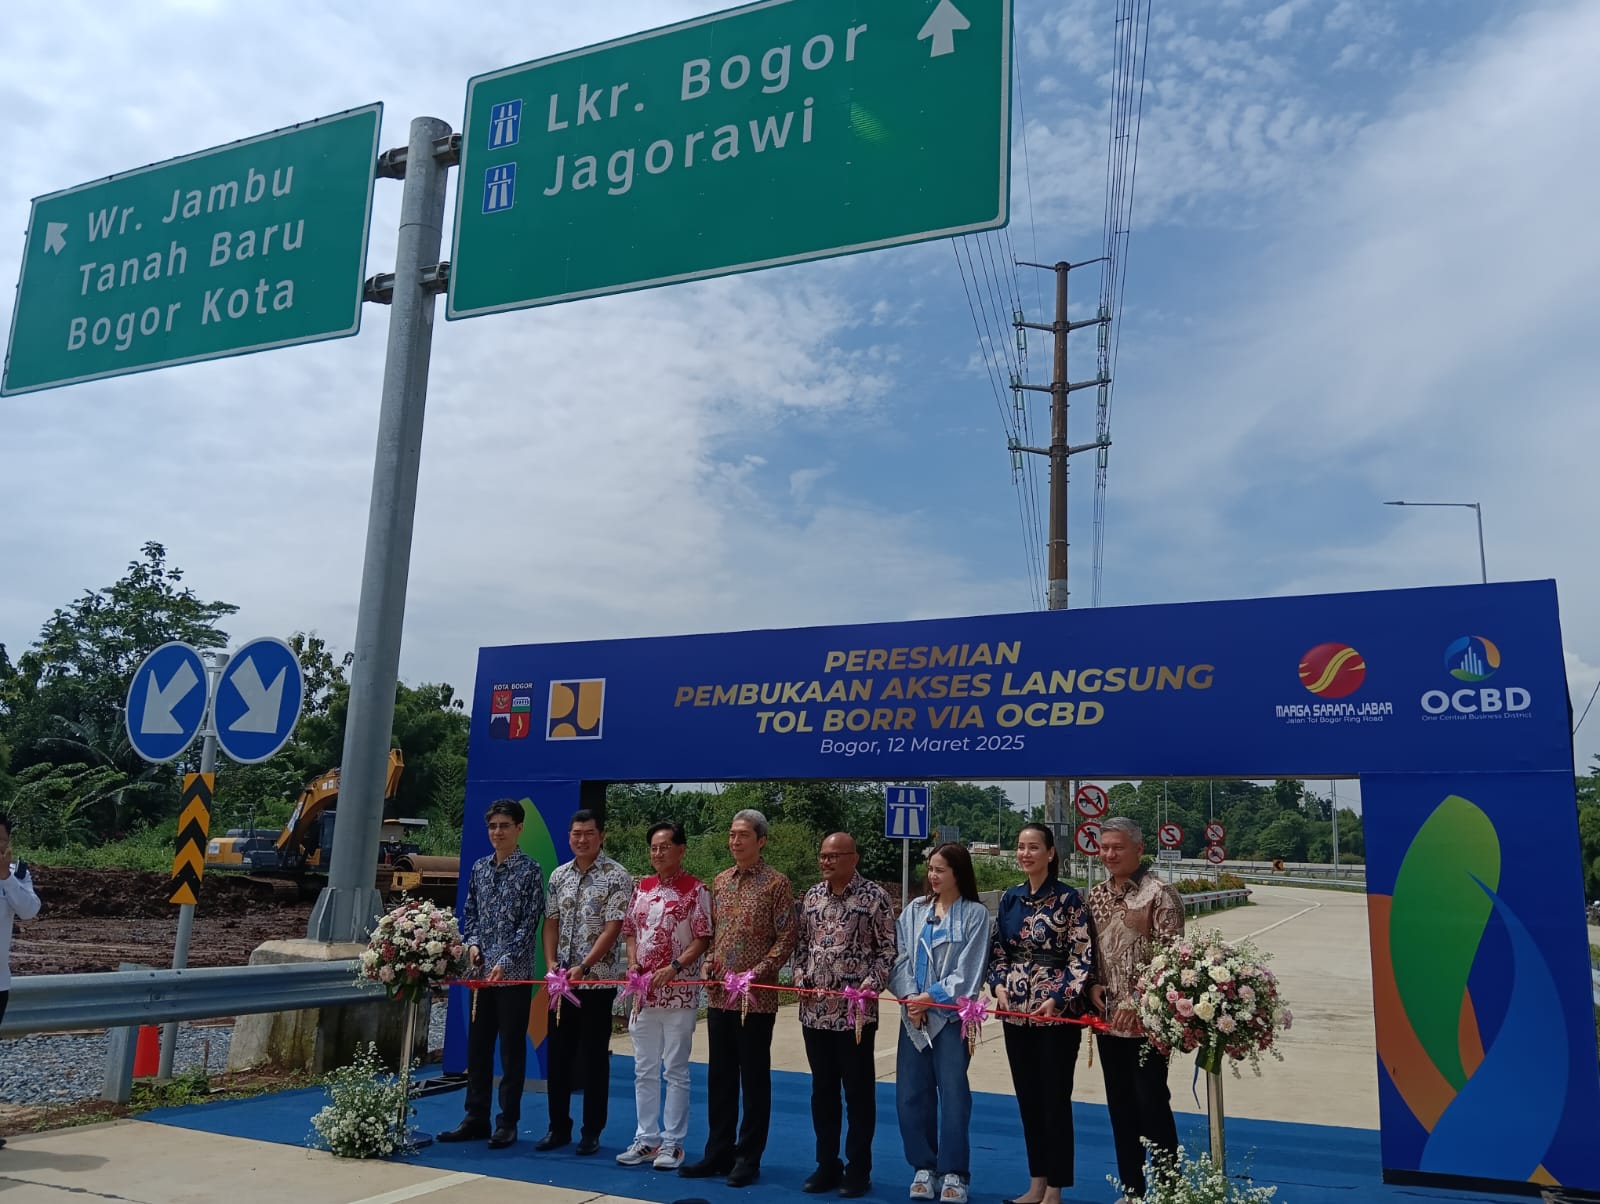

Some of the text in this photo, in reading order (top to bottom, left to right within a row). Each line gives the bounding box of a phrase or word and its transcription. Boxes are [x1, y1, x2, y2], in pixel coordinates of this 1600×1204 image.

[546, 24, 868, 133] Lkr. Bogor
[543, 97, 815, 196] Jagorawi
[87, 166, 294, 242] Wr. Jambu
[79, 219, 305, 296] Tanah Baru
[68, 279, 294, 351] Bogor Kota
[824, 641, 1021, 673] PERESMIAN
[493, 682, 533, 691] KOTA BOGOR
[674, 664, 1215, 708] PEMBUKAAN AKSES LANGSUNG
[1421, 687, 1531, 714] OCBD
[756, 701, 1104, 734] TOL BORR VIA OCBD
[1275, 702, 1393, 718] MARGA SARANA JABAR
[820, 735, 1025, 757] Bogor, 12 Maret 2025
